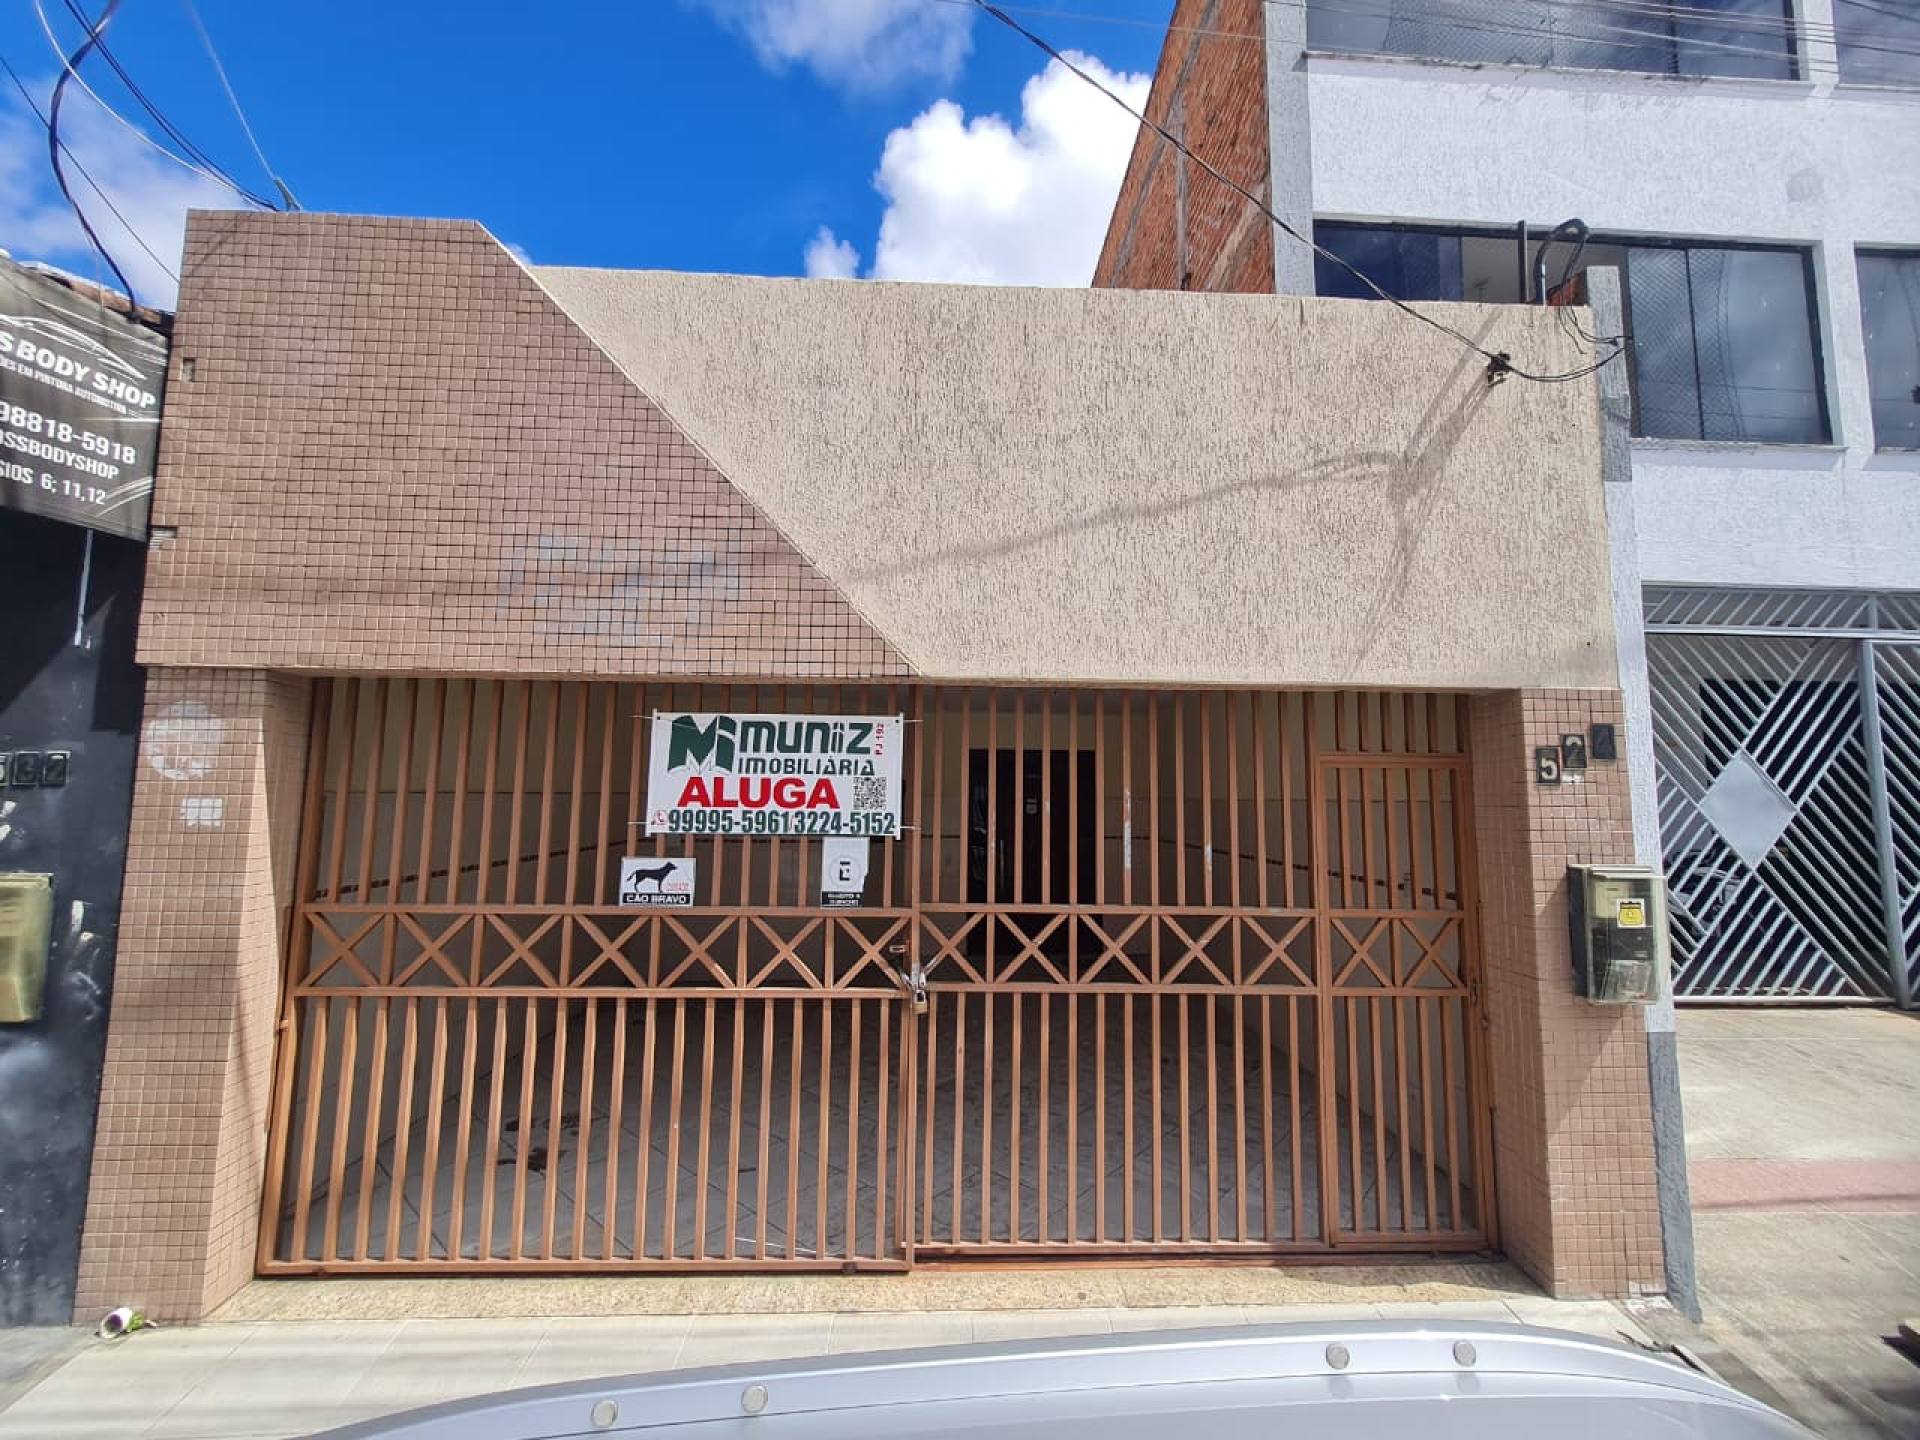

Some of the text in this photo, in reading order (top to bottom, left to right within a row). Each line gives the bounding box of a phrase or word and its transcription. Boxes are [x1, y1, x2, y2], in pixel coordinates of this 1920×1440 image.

[16, 340, 90, 382] BODY
[92, 372, 156, 409] SHOP
[0, 402, 136, 465] 98818-5918
[677, 776, 841, 809] ALUGA
